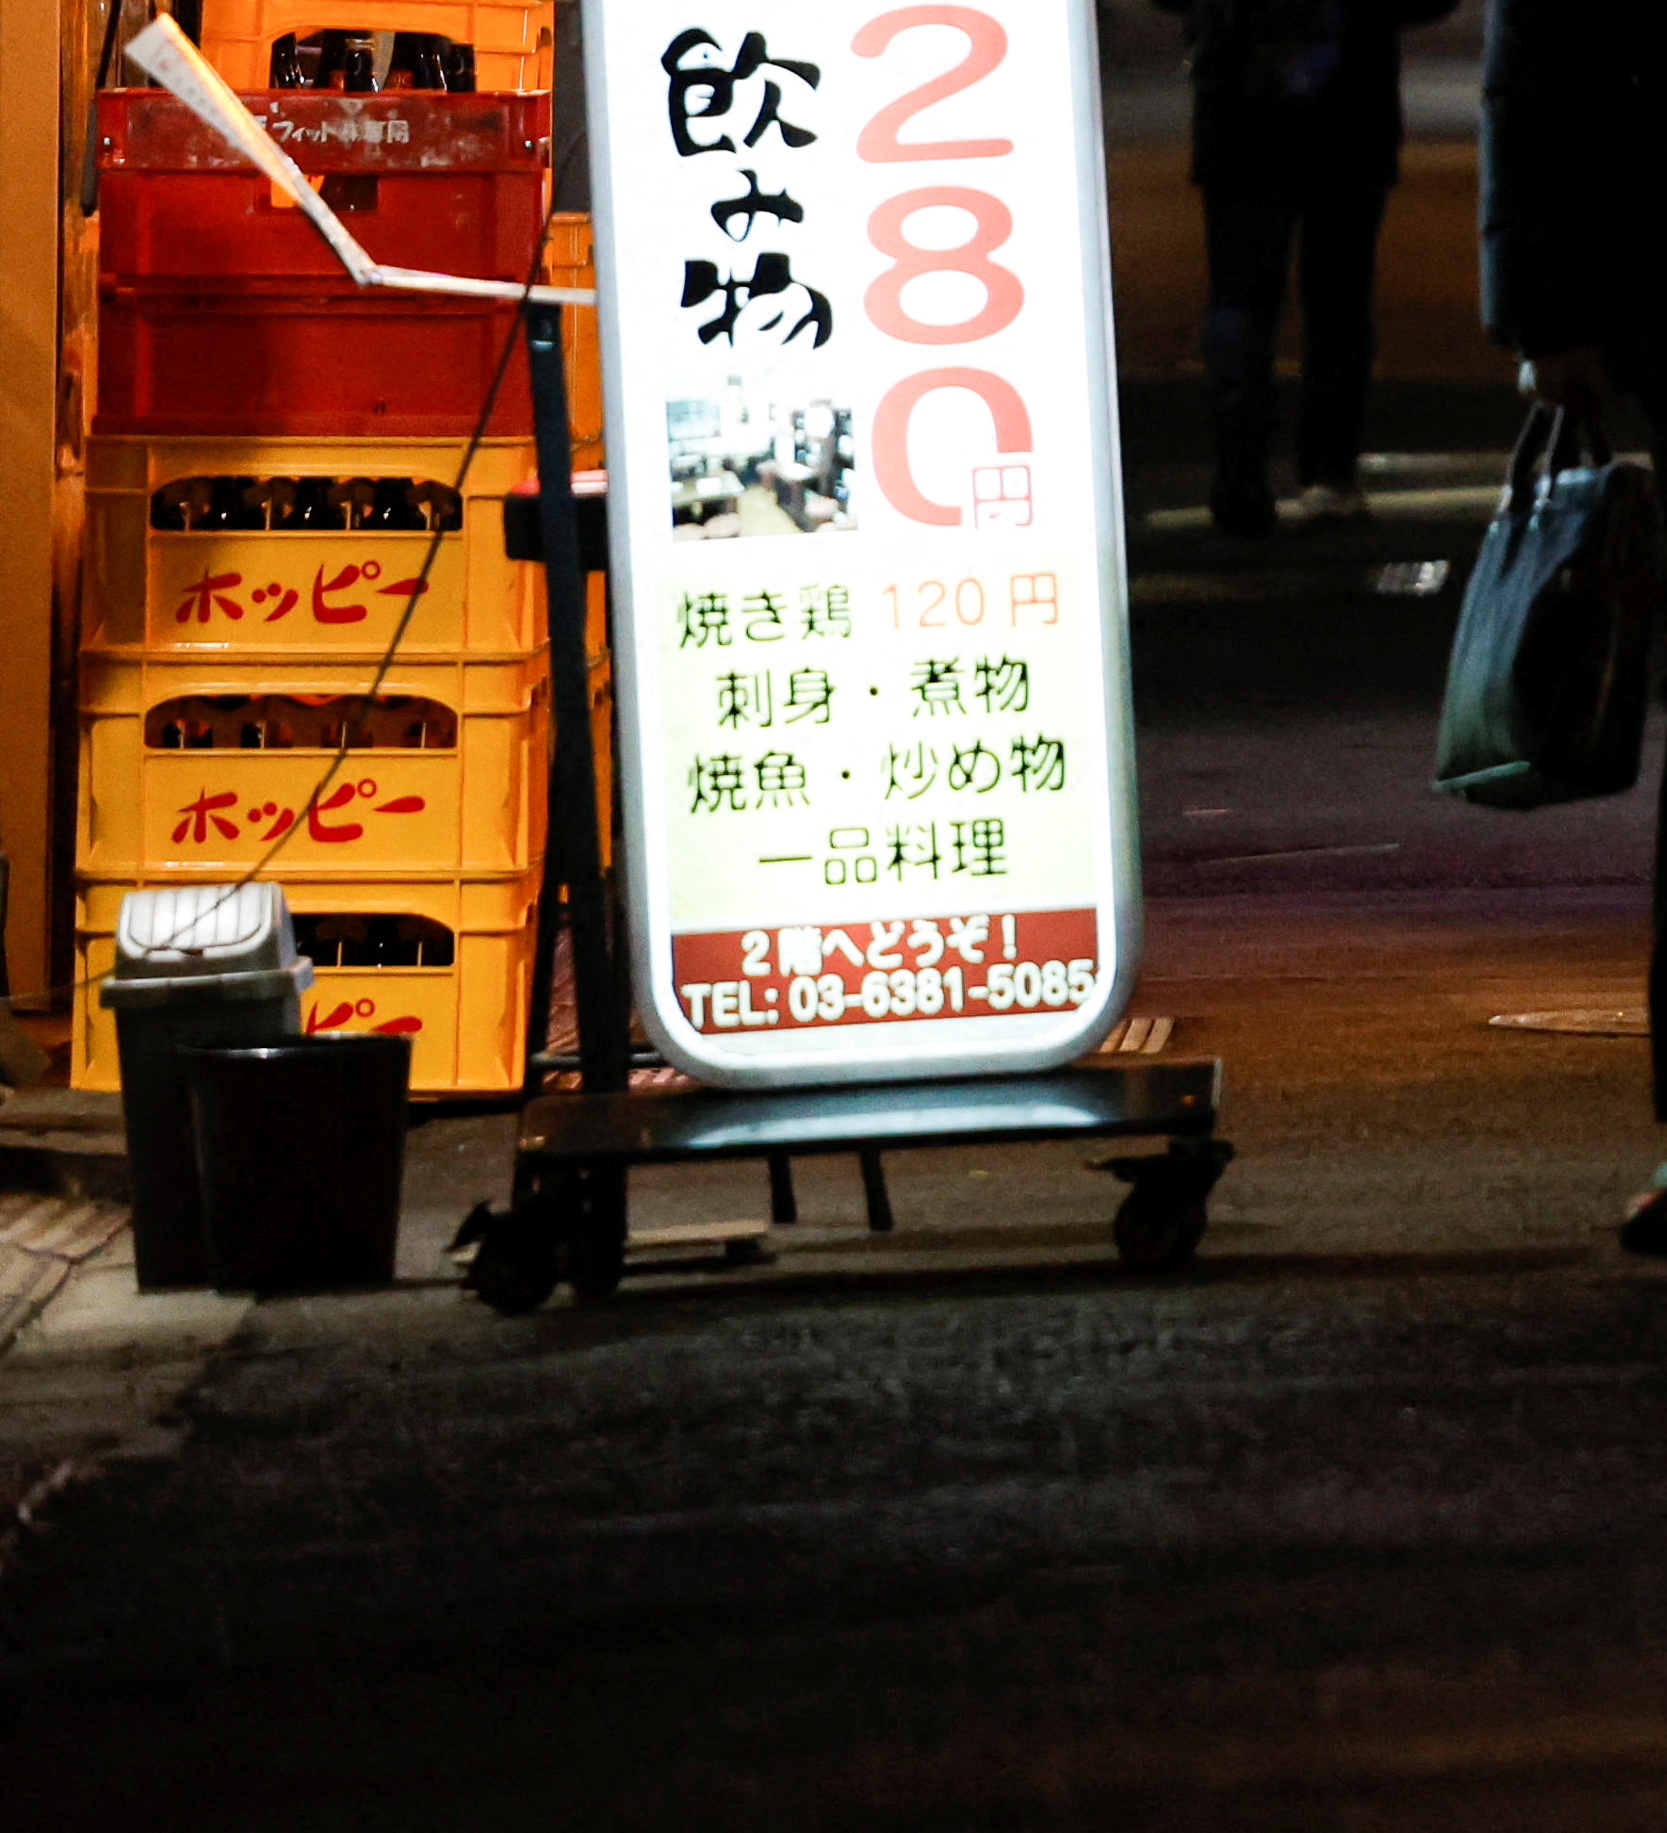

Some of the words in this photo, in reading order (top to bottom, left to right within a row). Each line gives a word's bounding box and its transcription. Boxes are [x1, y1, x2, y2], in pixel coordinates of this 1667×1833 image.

[660, 27, 835, 350] 飲み物
[175, 559, 431, 624] ホッピー
[677, 582, 854, 649] 焼き鶏
[715, 655, 1031, 730] 刺身・煮物
[687, 732, 1067, 816] 焼魚・炒め物
[171, 777, 427, 844] ホッピー
[758, 817, 1009, 886] 一品料理
